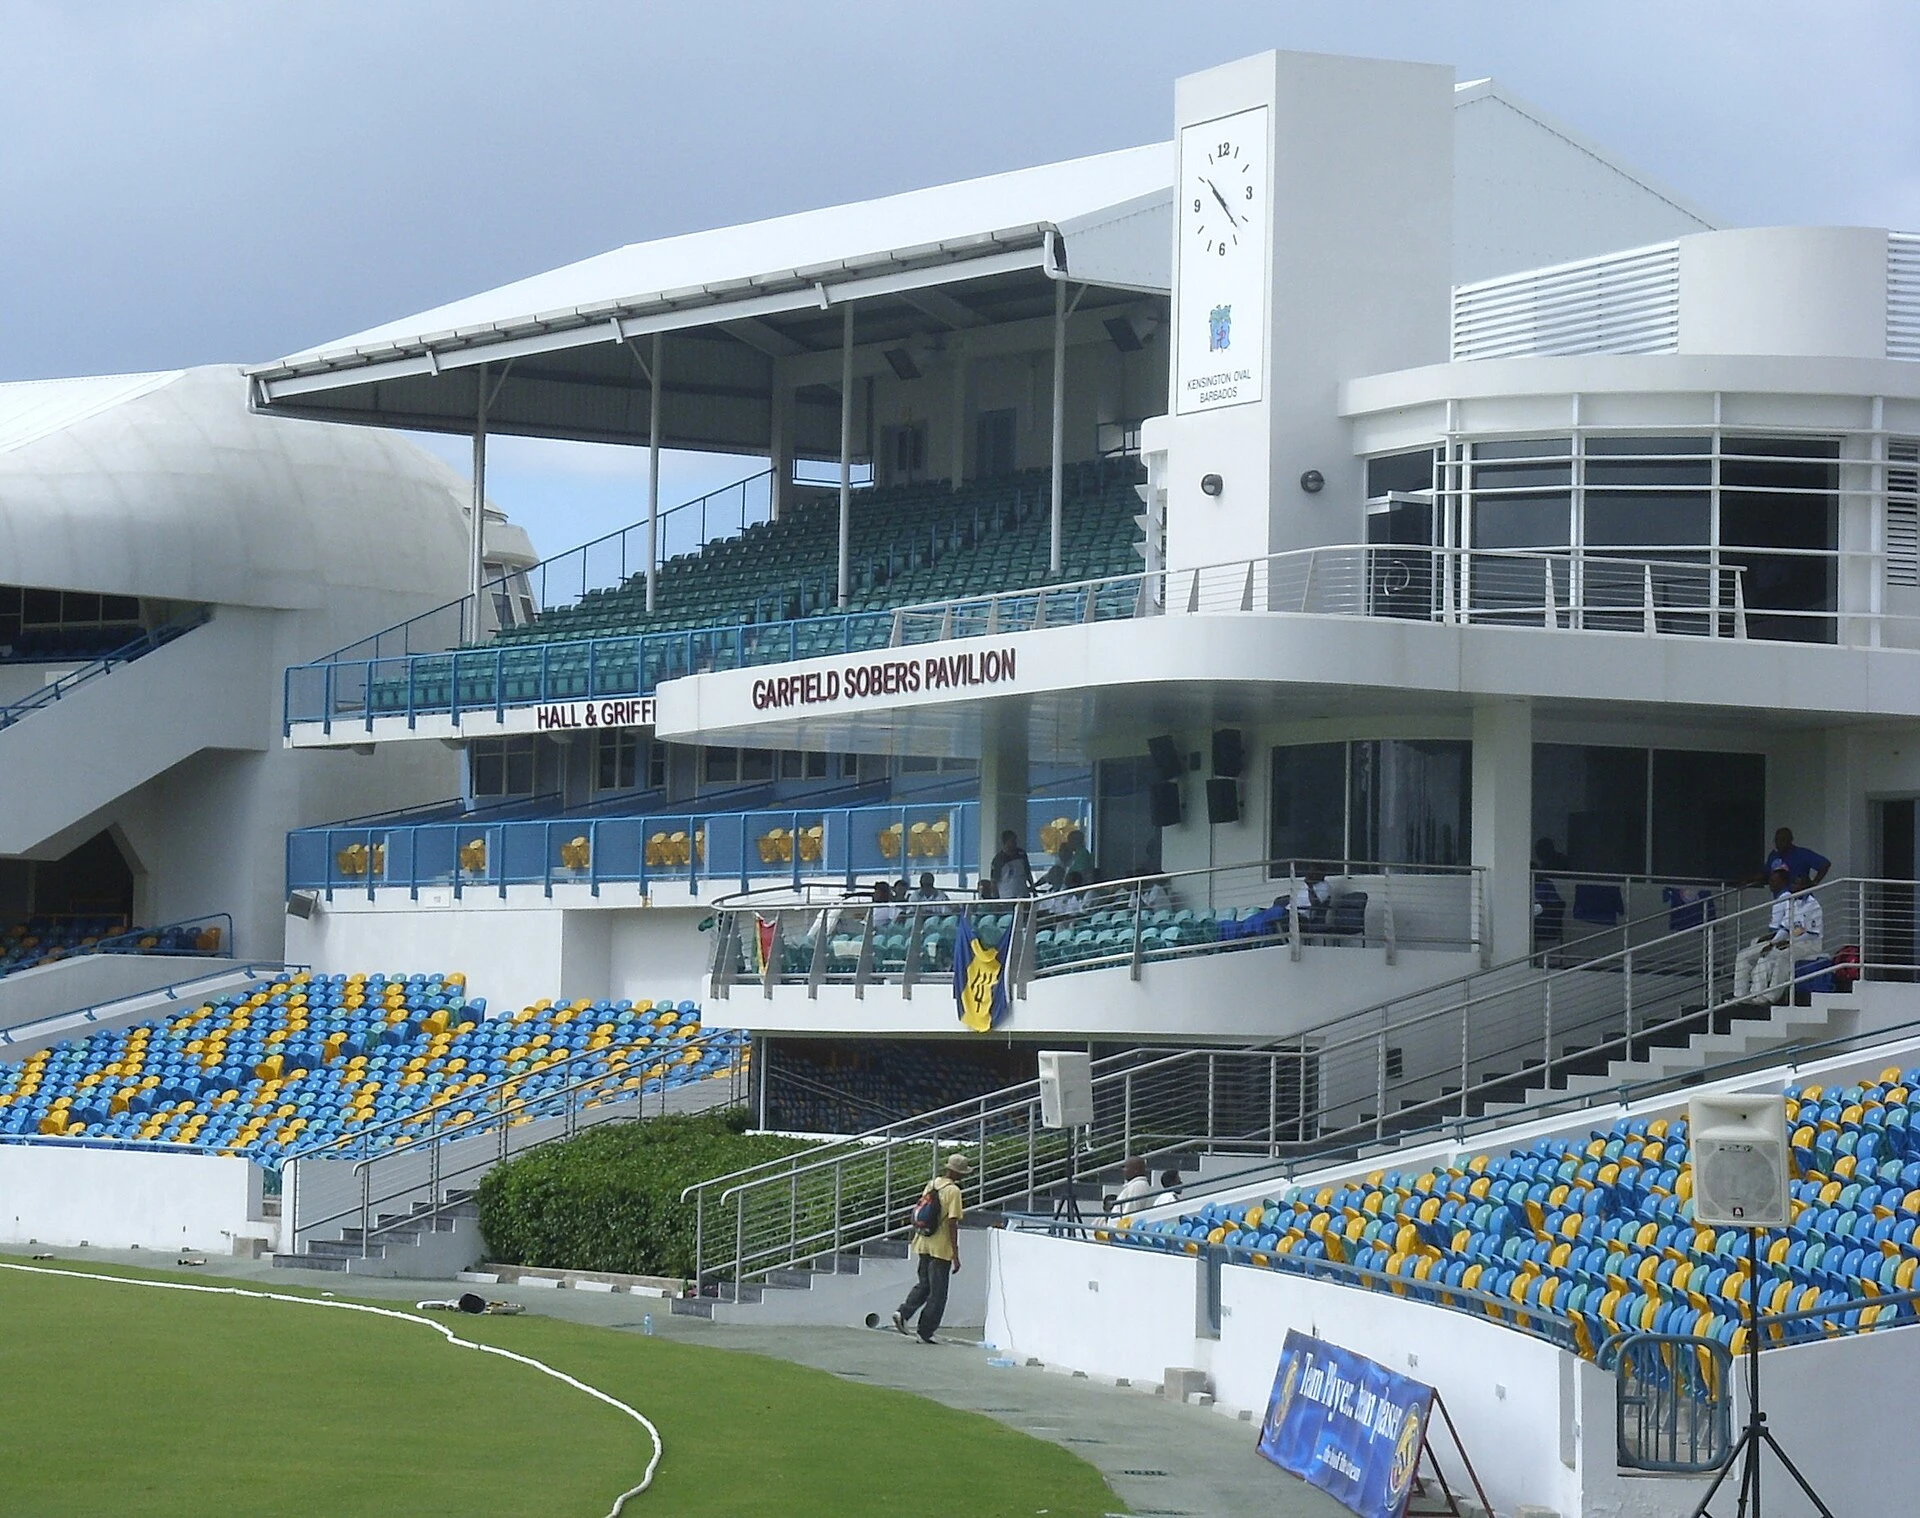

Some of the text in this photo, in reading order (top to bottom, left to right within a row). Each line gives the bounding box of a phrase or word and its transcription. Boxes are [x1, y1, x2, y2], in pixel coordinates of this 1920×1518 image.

[1217, 142, 1231, 158] 12
[1245, 185, 1253, 200] 3
[1194, 199, 1201, 213] 9
[1218, 242, 1226, 257] 6
[1187, 369, 1251, 390] KENSINGTON OVAL
[1200, 386, 1238, 403] BARBADOS
[752, 647, 1016, 710] GARFIELD SOBERS PAVILION
[537, 704, 582, 730] HALL
[585, 703, 598, 727] &
